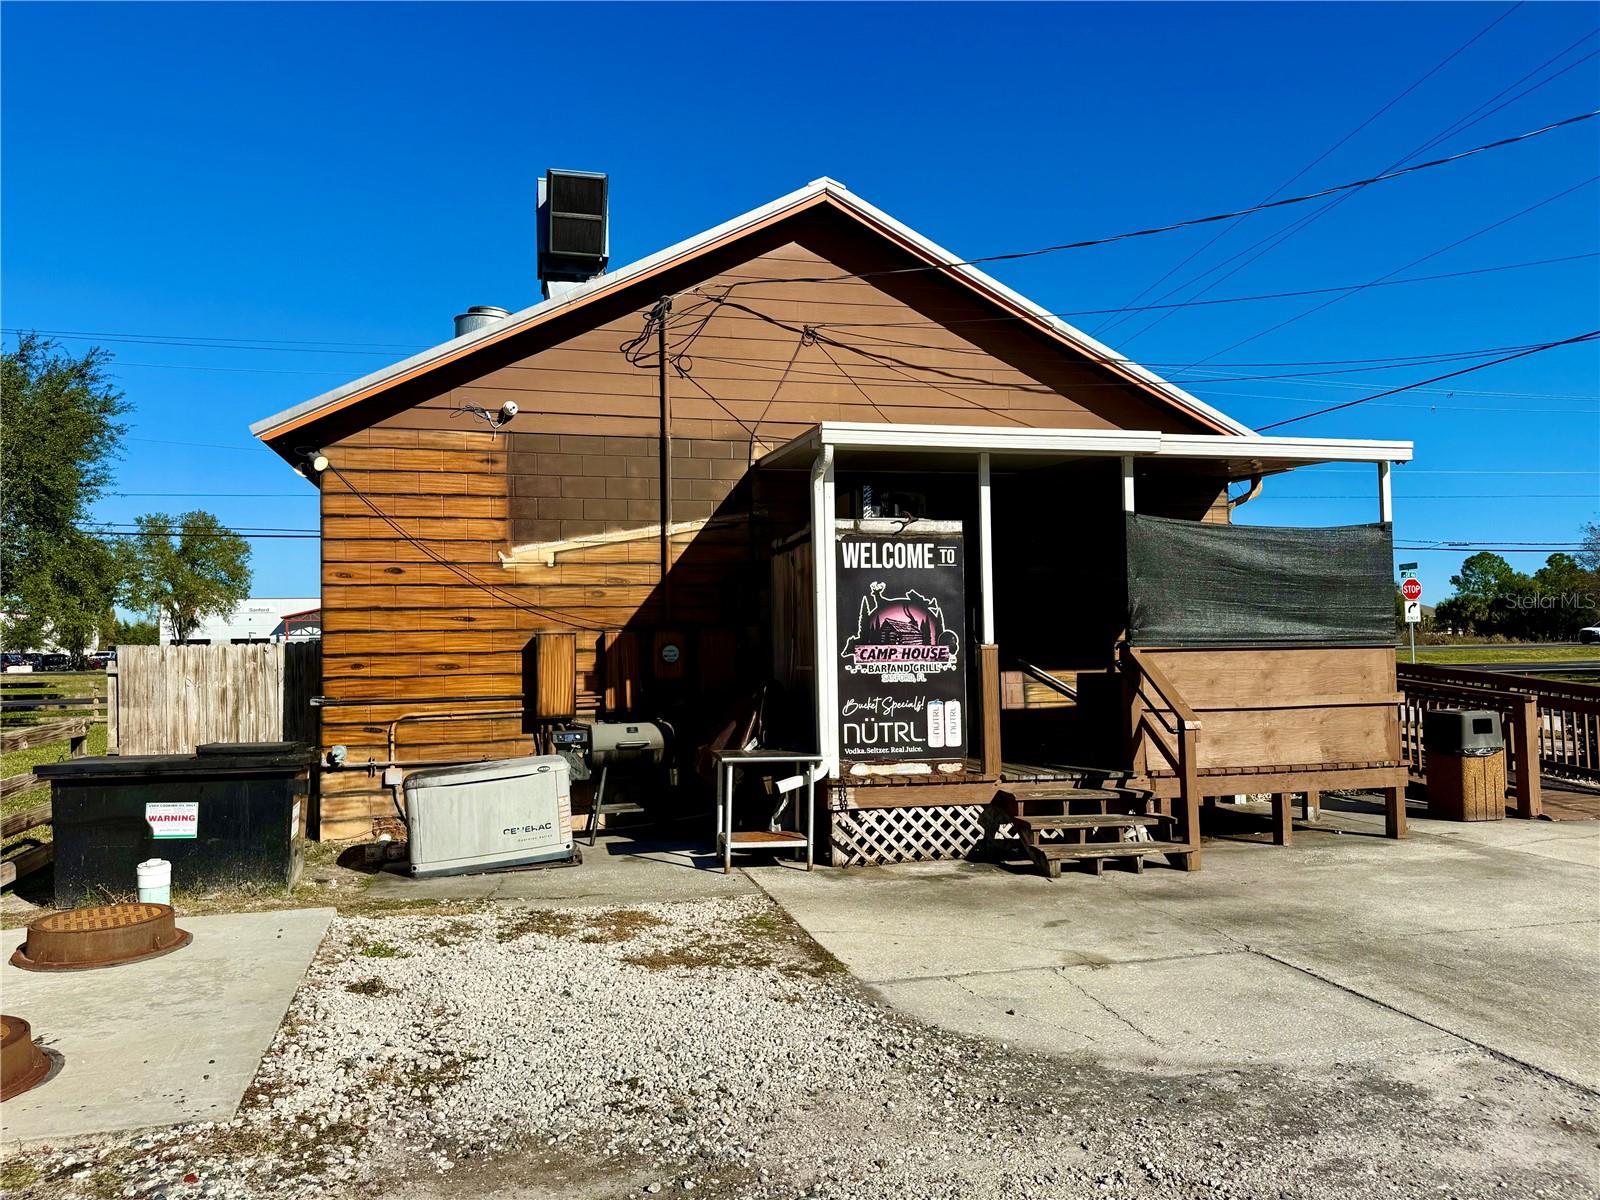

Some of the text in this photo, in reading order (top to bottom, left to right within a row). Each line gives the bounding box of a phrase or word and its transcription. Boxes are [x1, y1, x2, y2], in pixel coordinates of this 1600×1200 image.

[842, 542, 956, 569] WELCOME TO
[1403, 585, 1421, 594] STOP
[860, 647, 948, 660] CAMP HOUSE
[868, 663, 940, 673] BAR AND GRILL
[842, 696, 882, 717] Bucket
[844, 745, 923, 755] Vodka. Seltzer. Real Juice.
[148, 814, 196, 822] WARNING
